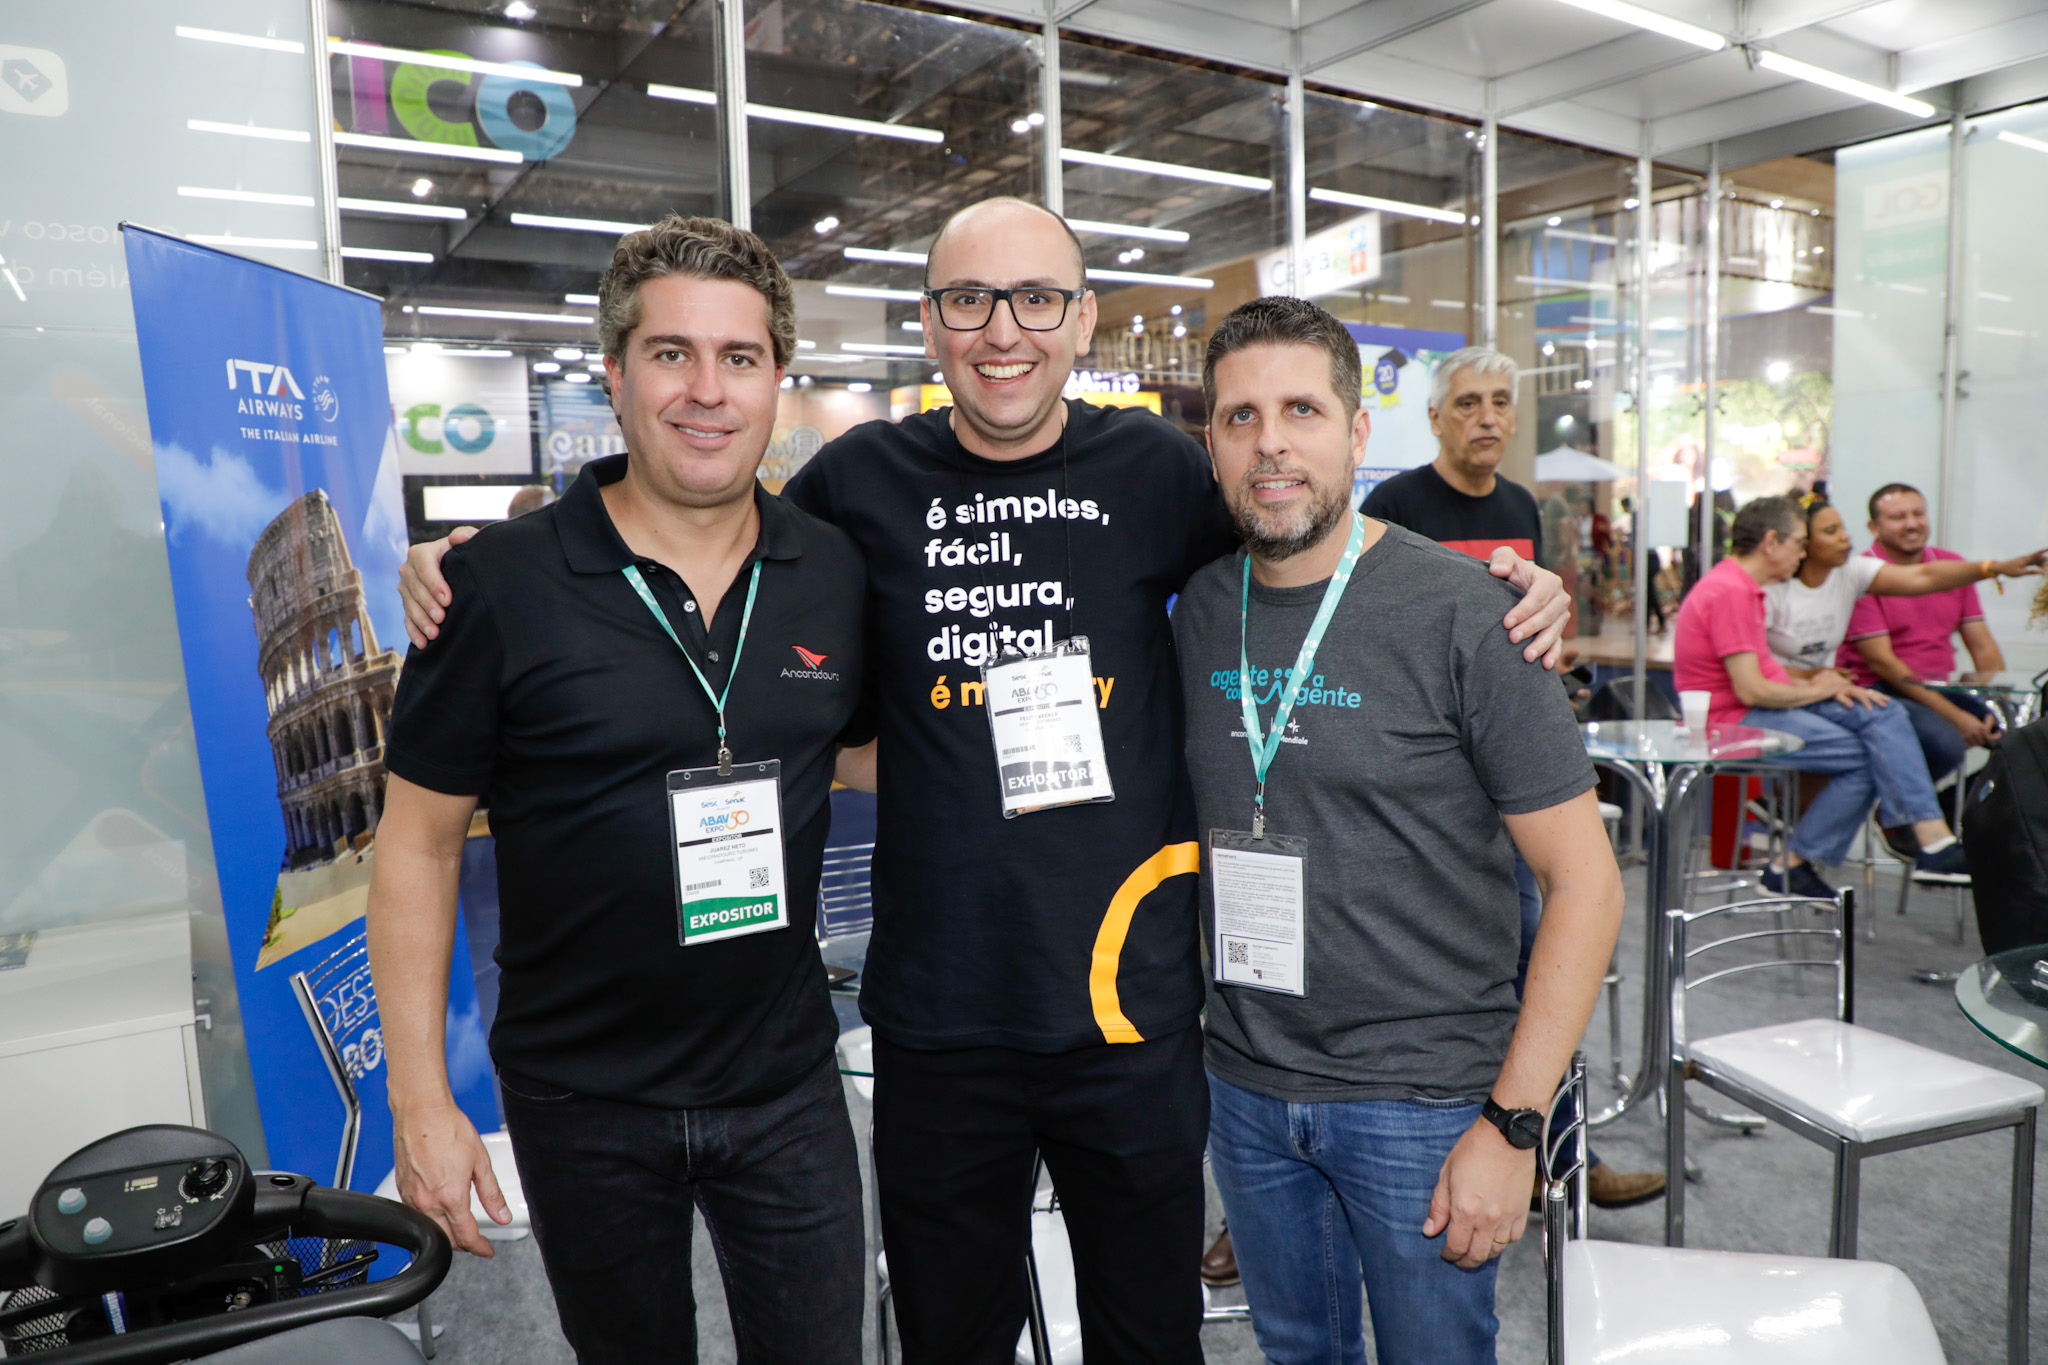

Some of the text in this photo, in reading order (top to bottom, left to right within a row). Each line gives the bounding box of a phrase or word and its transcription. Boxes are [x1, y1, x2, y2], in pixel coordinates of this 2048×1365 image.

[328, 36, 577, 161] ICO
[226, 358, 306, 400] ITA
[238, 397, 304, 421] AIRWAYS
[240, 427, 338, 446] THE ITALIAN AIRLINE
[926, 488, 1110, 530] é simples,
[924, 532, 1023, 567] fácil,
[925, 581, 1075, 618] segura,
[931, 675, 951, 709] é
[1210, 664, 1269, 690] agete
[700, 813, 730, 828] ABAV
[706, 825, 724, 833] EXPO
[690, 901, 774, 930] EXPOSITOR
[342, 1028, 387, 1079] RO
